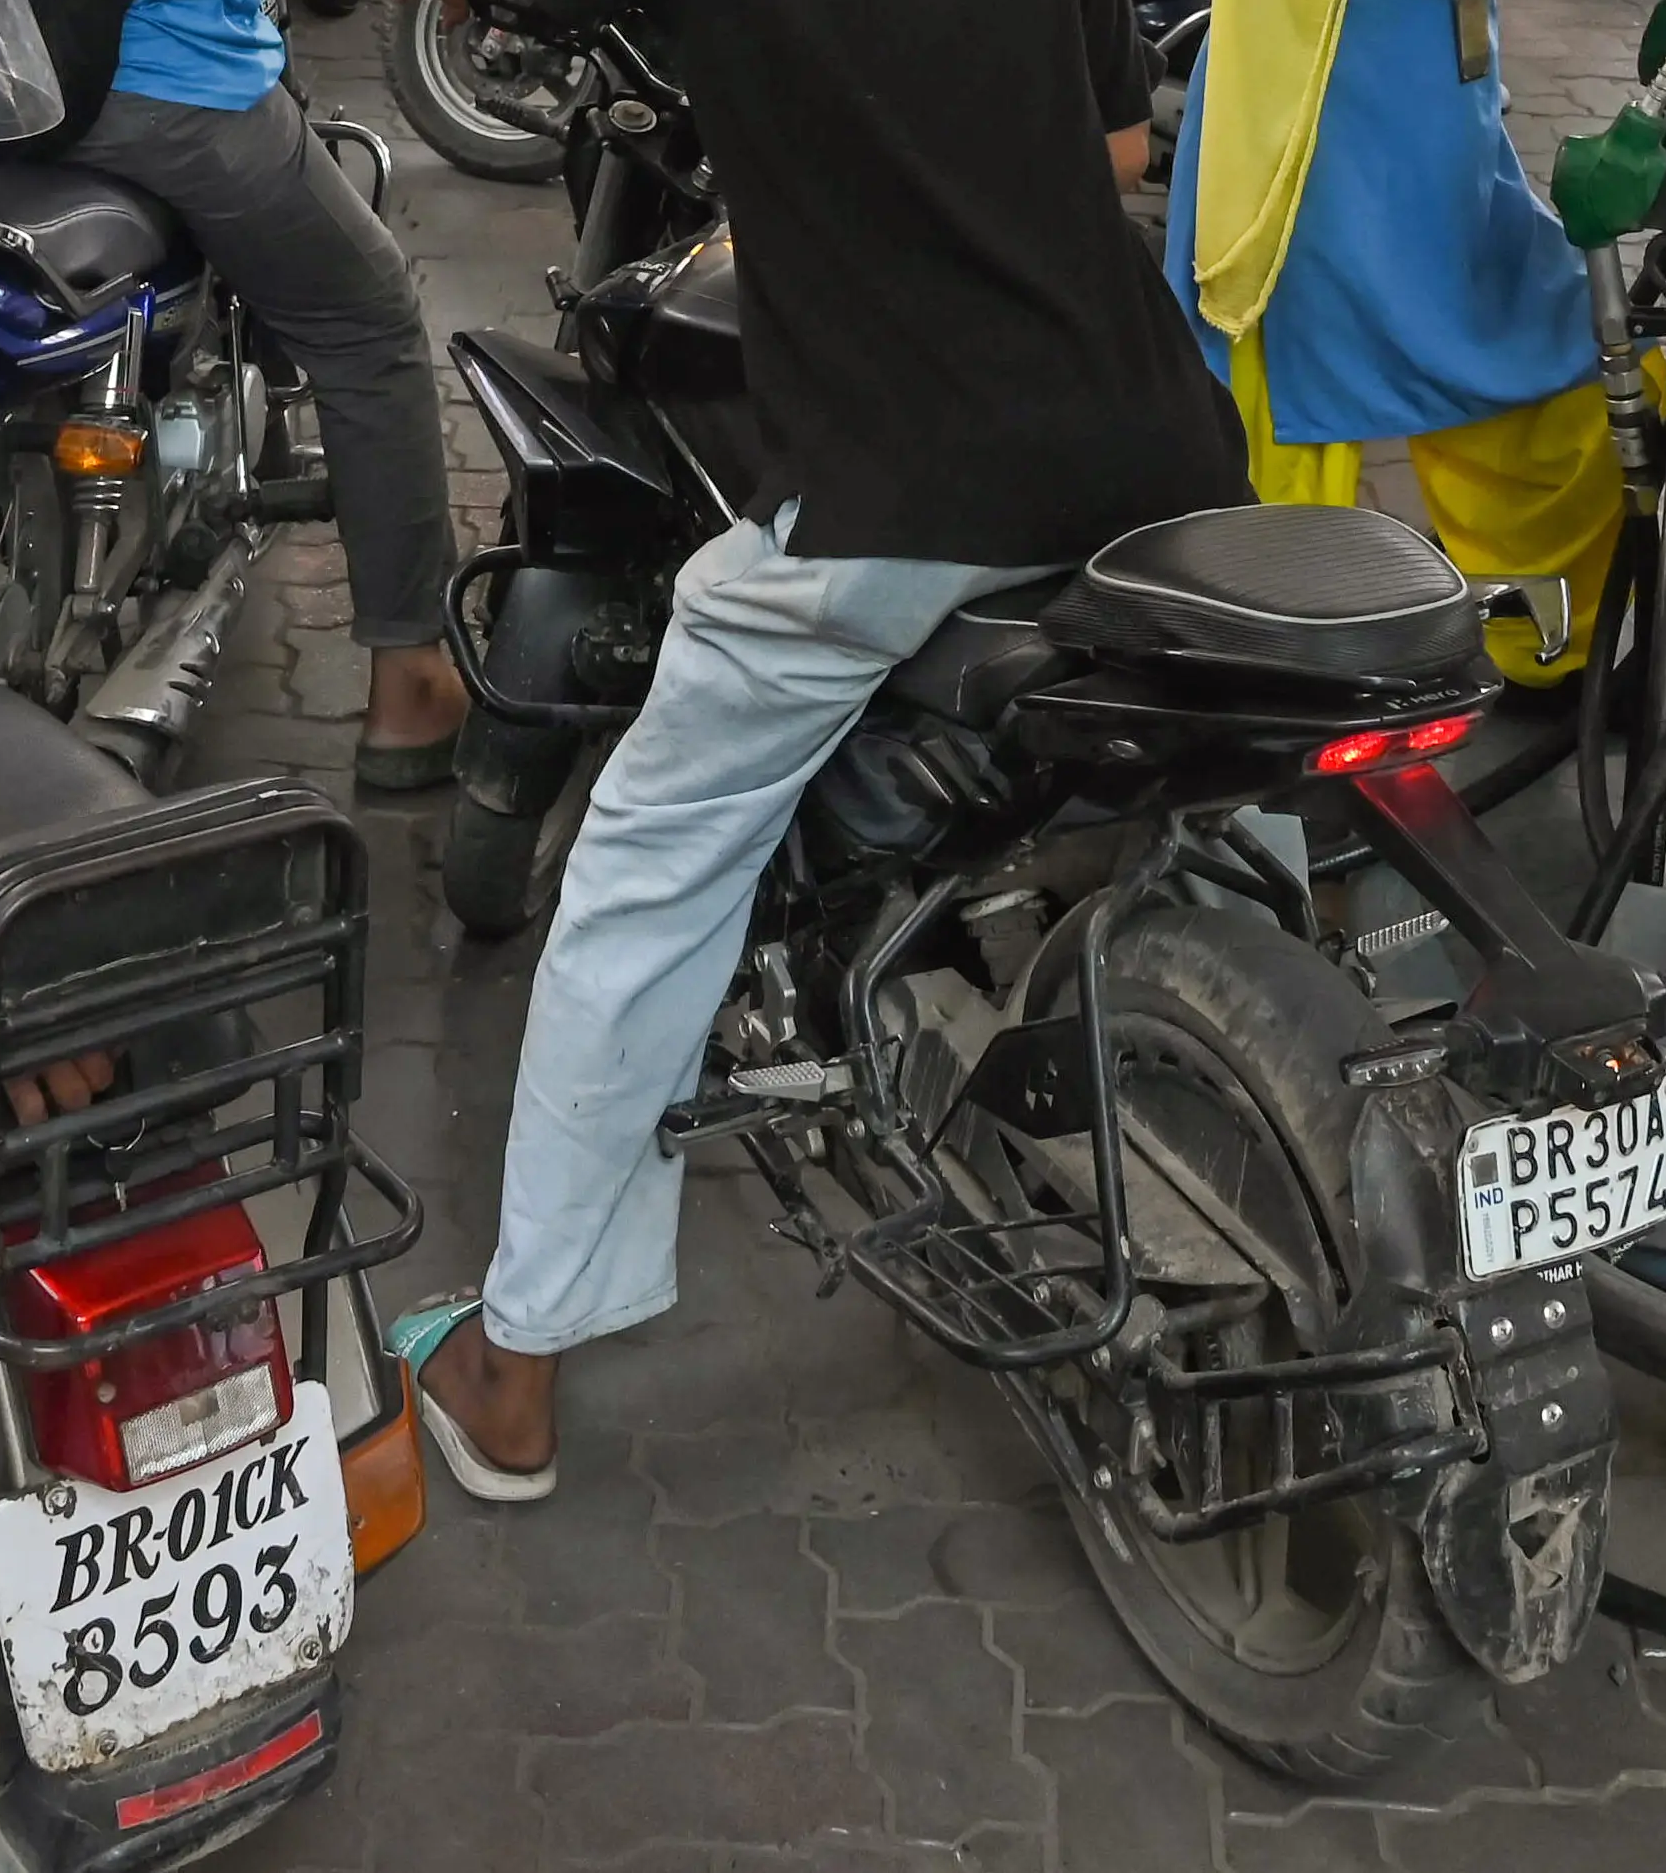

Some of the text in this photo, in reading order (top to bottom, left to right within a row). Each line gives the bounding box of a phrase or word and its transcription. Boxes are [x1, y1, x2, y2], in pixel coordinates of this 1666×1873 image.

[1474, 1187, 1504, 1210] IND
[1507, 1092, 1665, 1187] BR30A
[50, 1435, 310, 1615] BR-01CK
[61, 1534, 299, 1717] 8593
